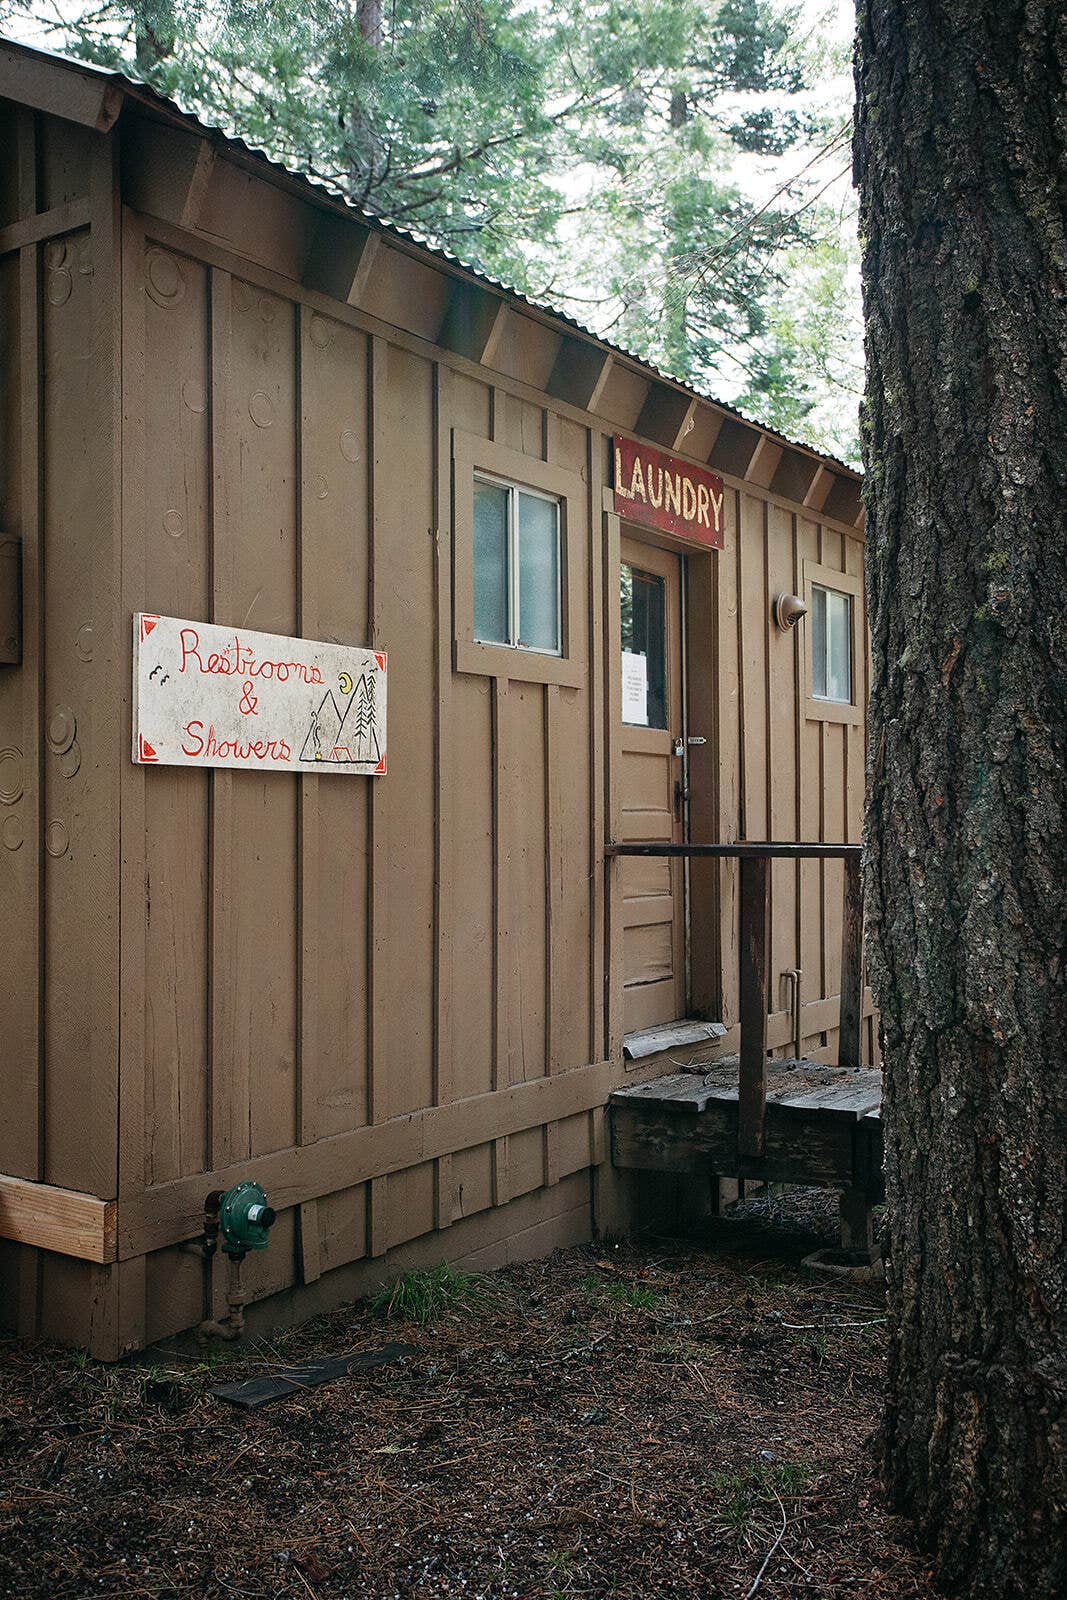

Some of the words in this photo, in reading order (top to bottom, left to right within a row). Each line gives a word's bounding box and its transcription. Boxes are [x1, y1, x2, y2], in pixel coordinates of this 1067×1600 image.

[615, 447, 723, 532] LAUNDRY
[178, 628, 325, 685] Restrooms
[239, 680, 259, 715] &
[181, 720, 291, 762] Showers
